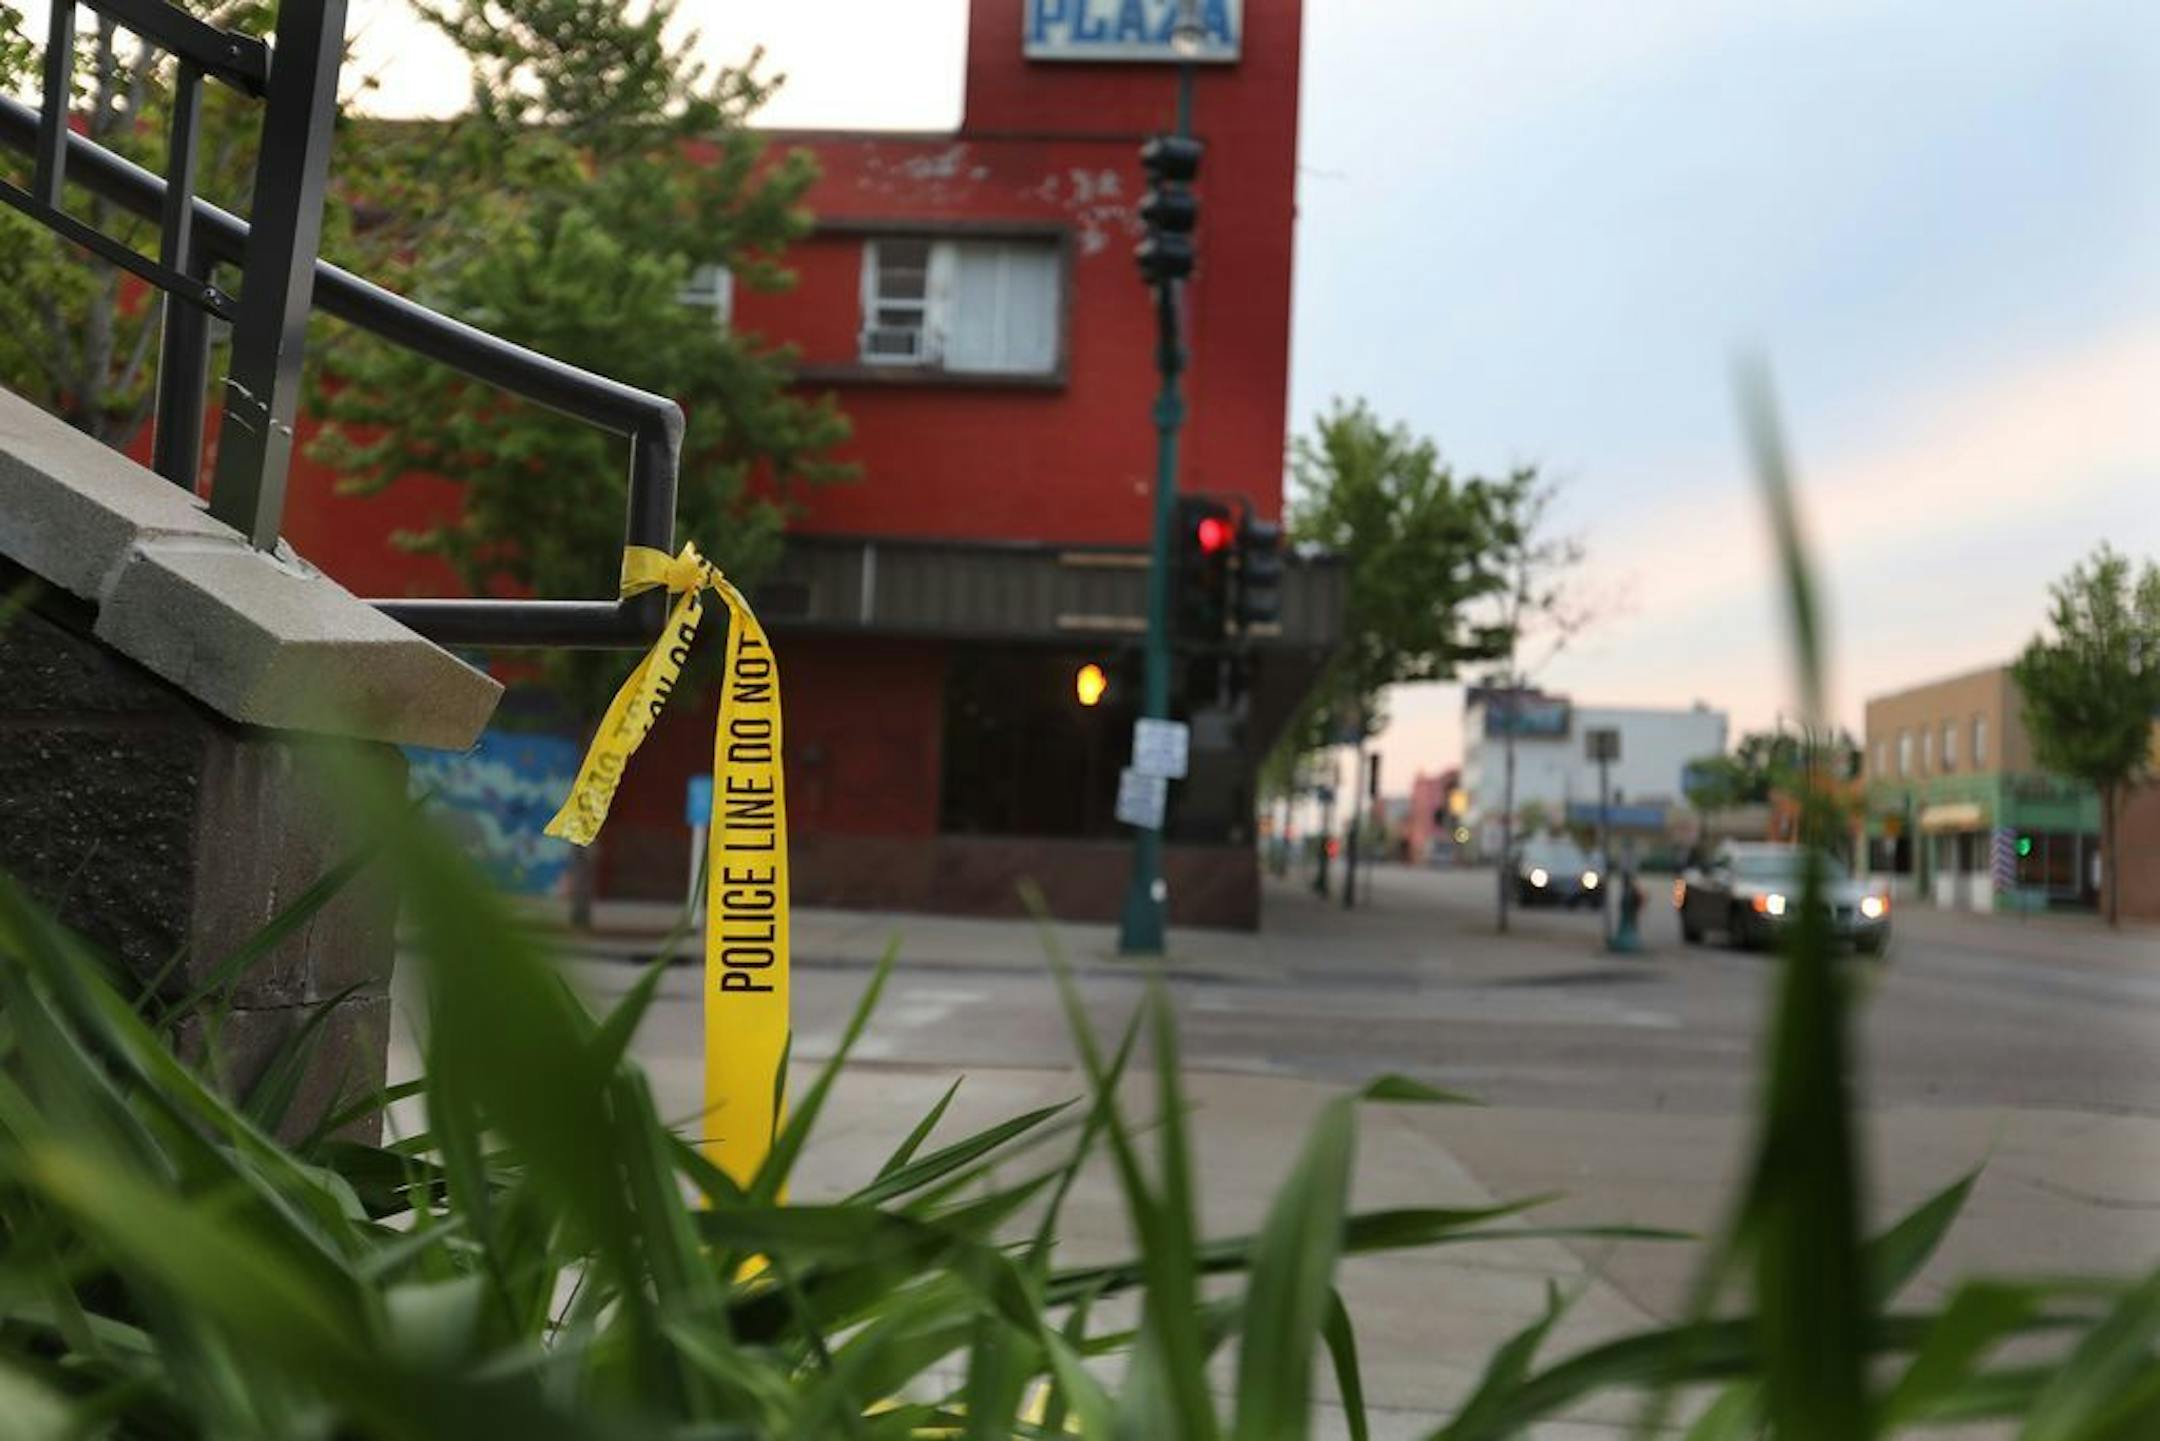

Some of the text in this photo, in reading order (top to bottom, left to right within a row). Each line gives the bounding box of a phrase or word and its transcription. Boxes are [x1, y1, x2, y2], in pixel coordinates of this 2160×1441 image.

[720, 631, 776, 992] POLICE LINE DO NOT
